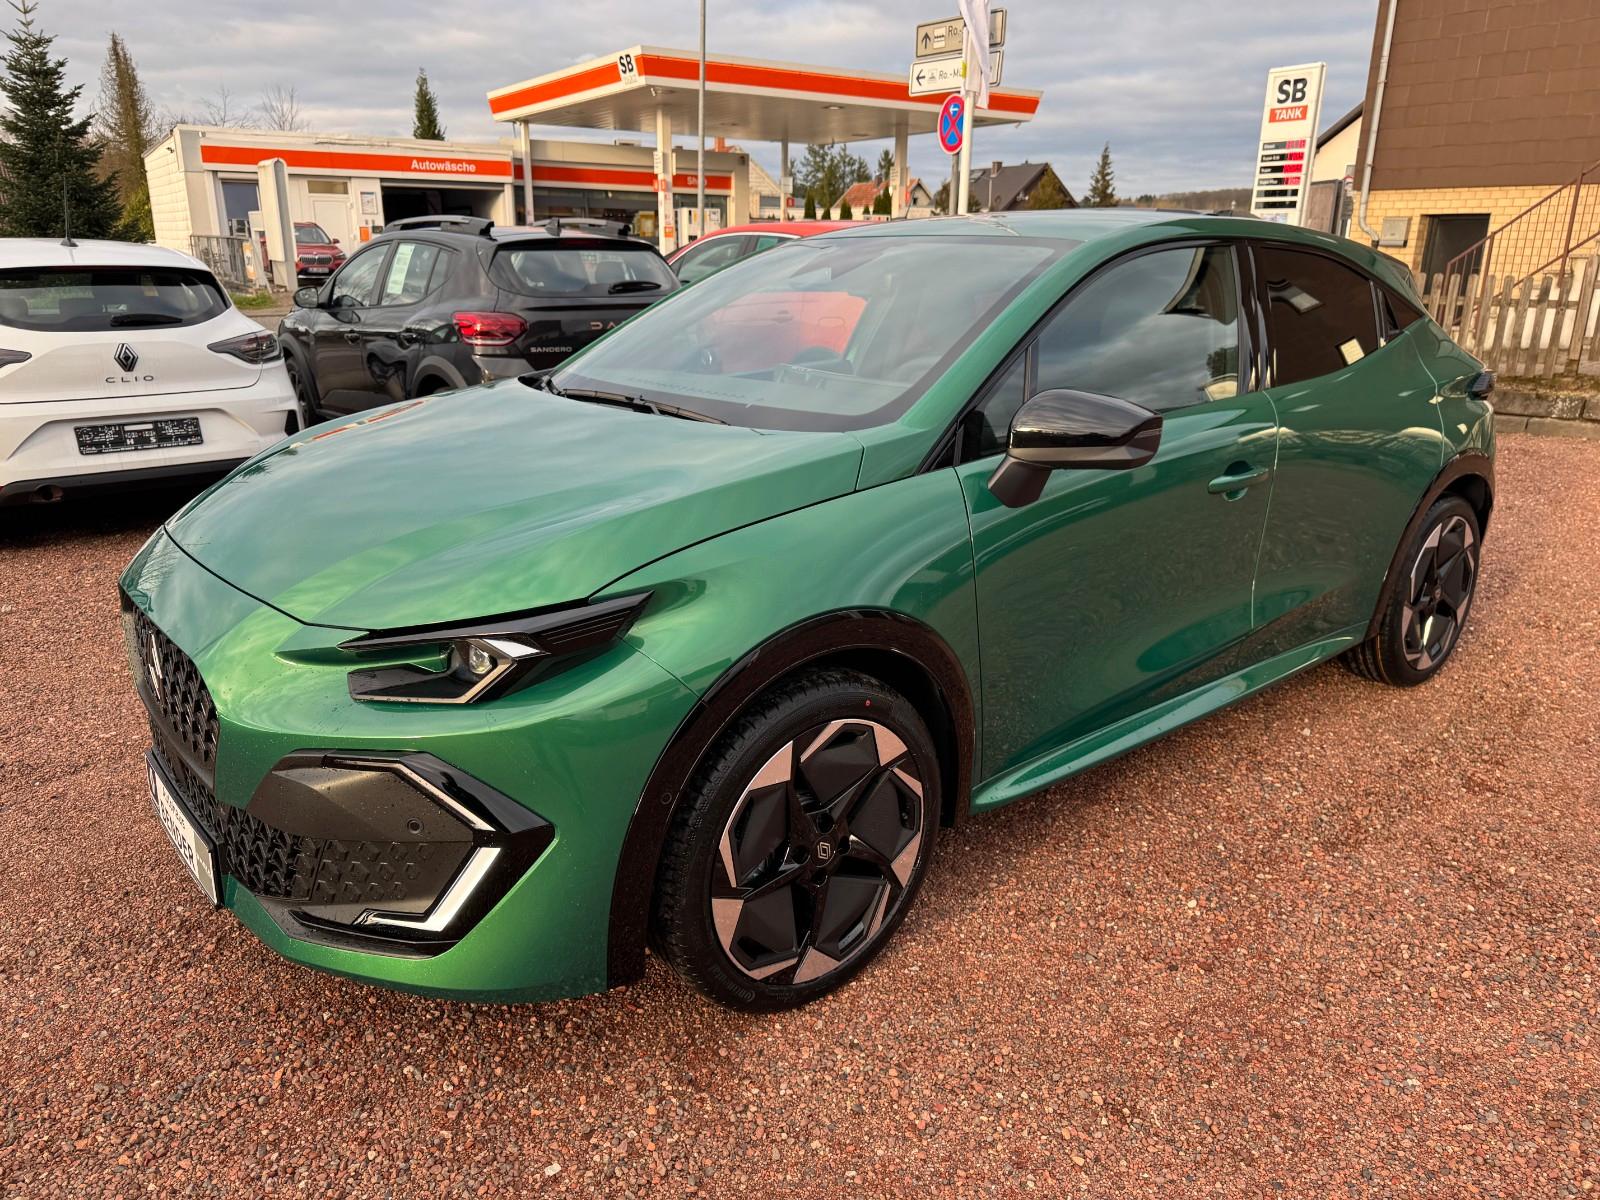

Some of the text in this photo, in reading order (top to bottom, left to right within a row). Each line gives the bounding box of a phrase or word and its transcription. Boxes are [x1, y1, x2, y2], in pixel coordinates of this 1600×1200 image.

[947, 25, 963, 37] Ro.-
[619, 54, 634, 74] SB
[1277, 78, 1308, 104] SB
[1275, 107, 1303, 121] TANK
[411, 159, 476, 173] Autowäsche
[687, 176, 708, 187] Shp
[105, 375, 155, 384] CLIO
